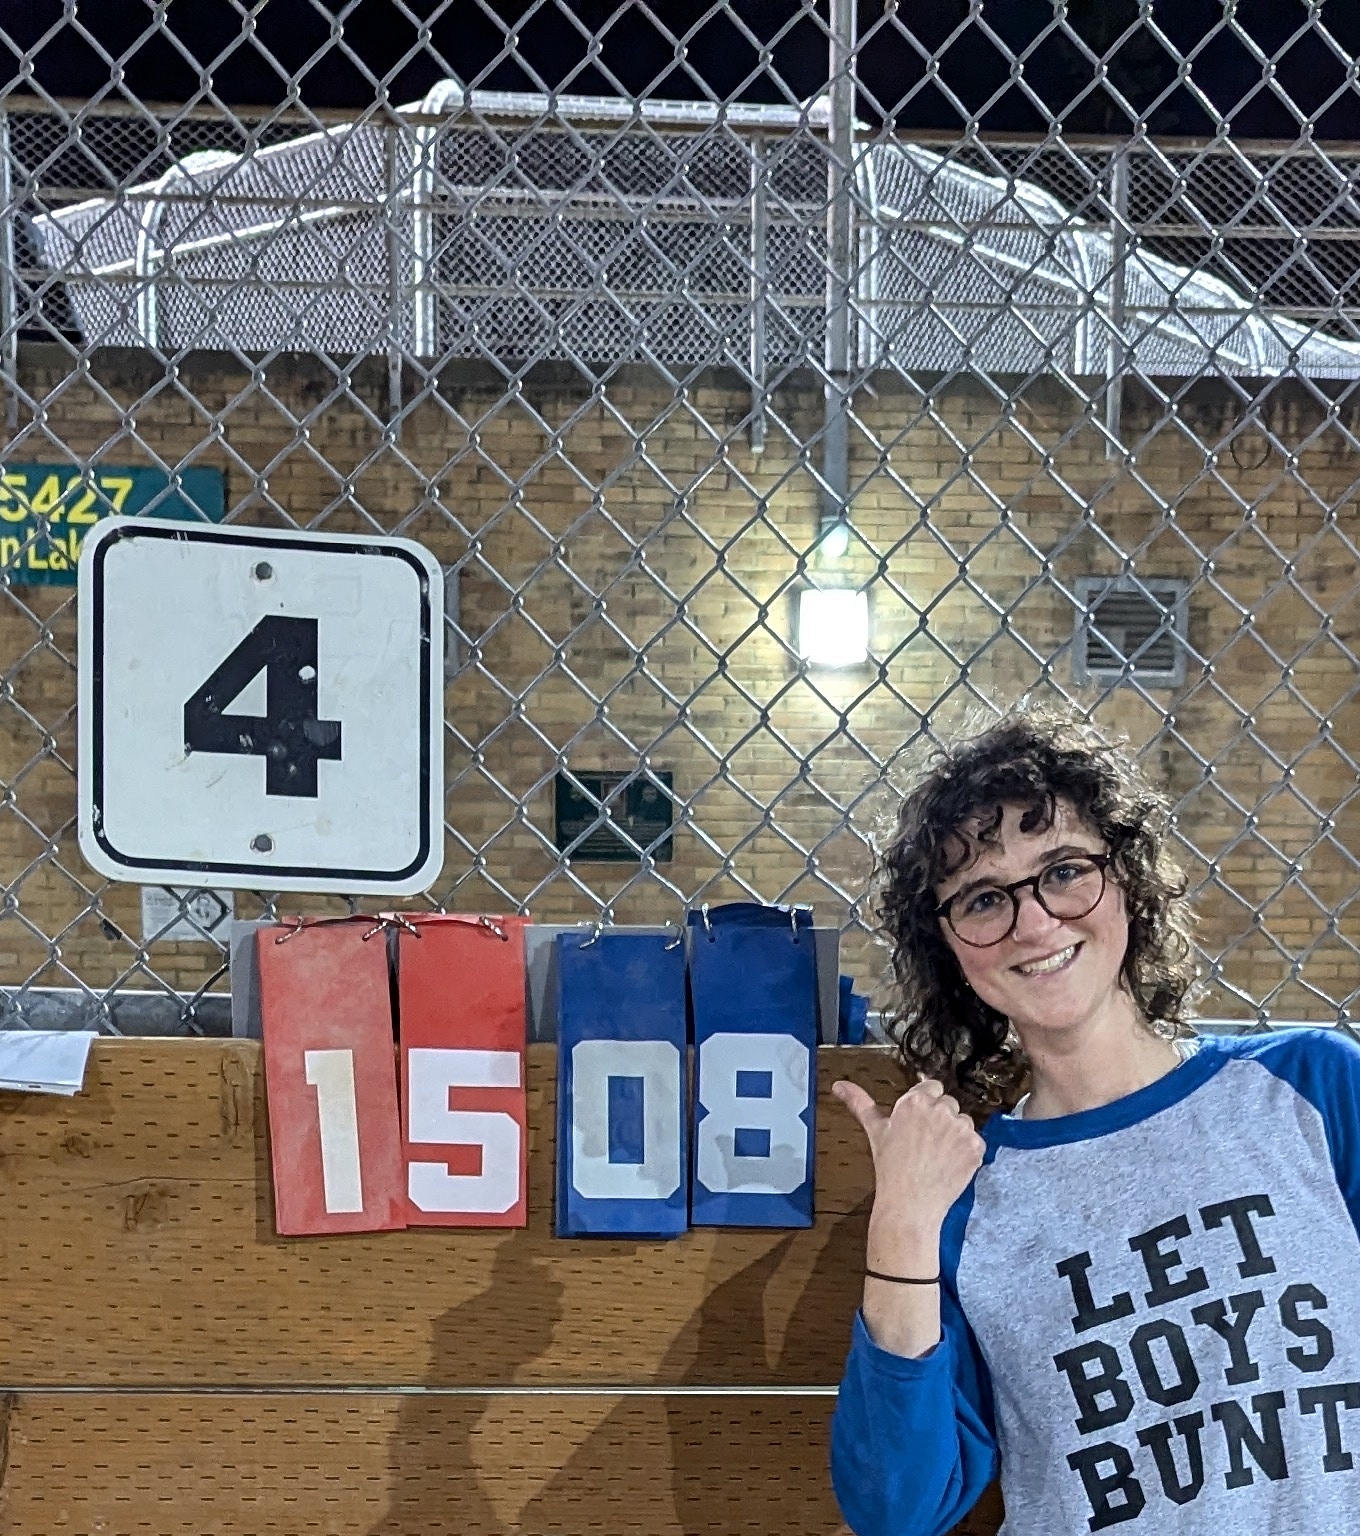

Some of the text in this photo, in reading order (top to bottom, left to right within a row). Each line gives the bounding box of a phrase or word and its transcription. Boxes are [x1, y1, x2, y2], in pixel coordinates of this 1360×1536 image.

[27, 528, 84, 570] Lak
[183, 614, 342, 798] 4
[304, 1048, 521, 1214] 15
[571, 1032, 810, 1200] 08
[1056, 1194, 1277, 1334] LET
[1053, 1283, 1335, 1435] BOYS
